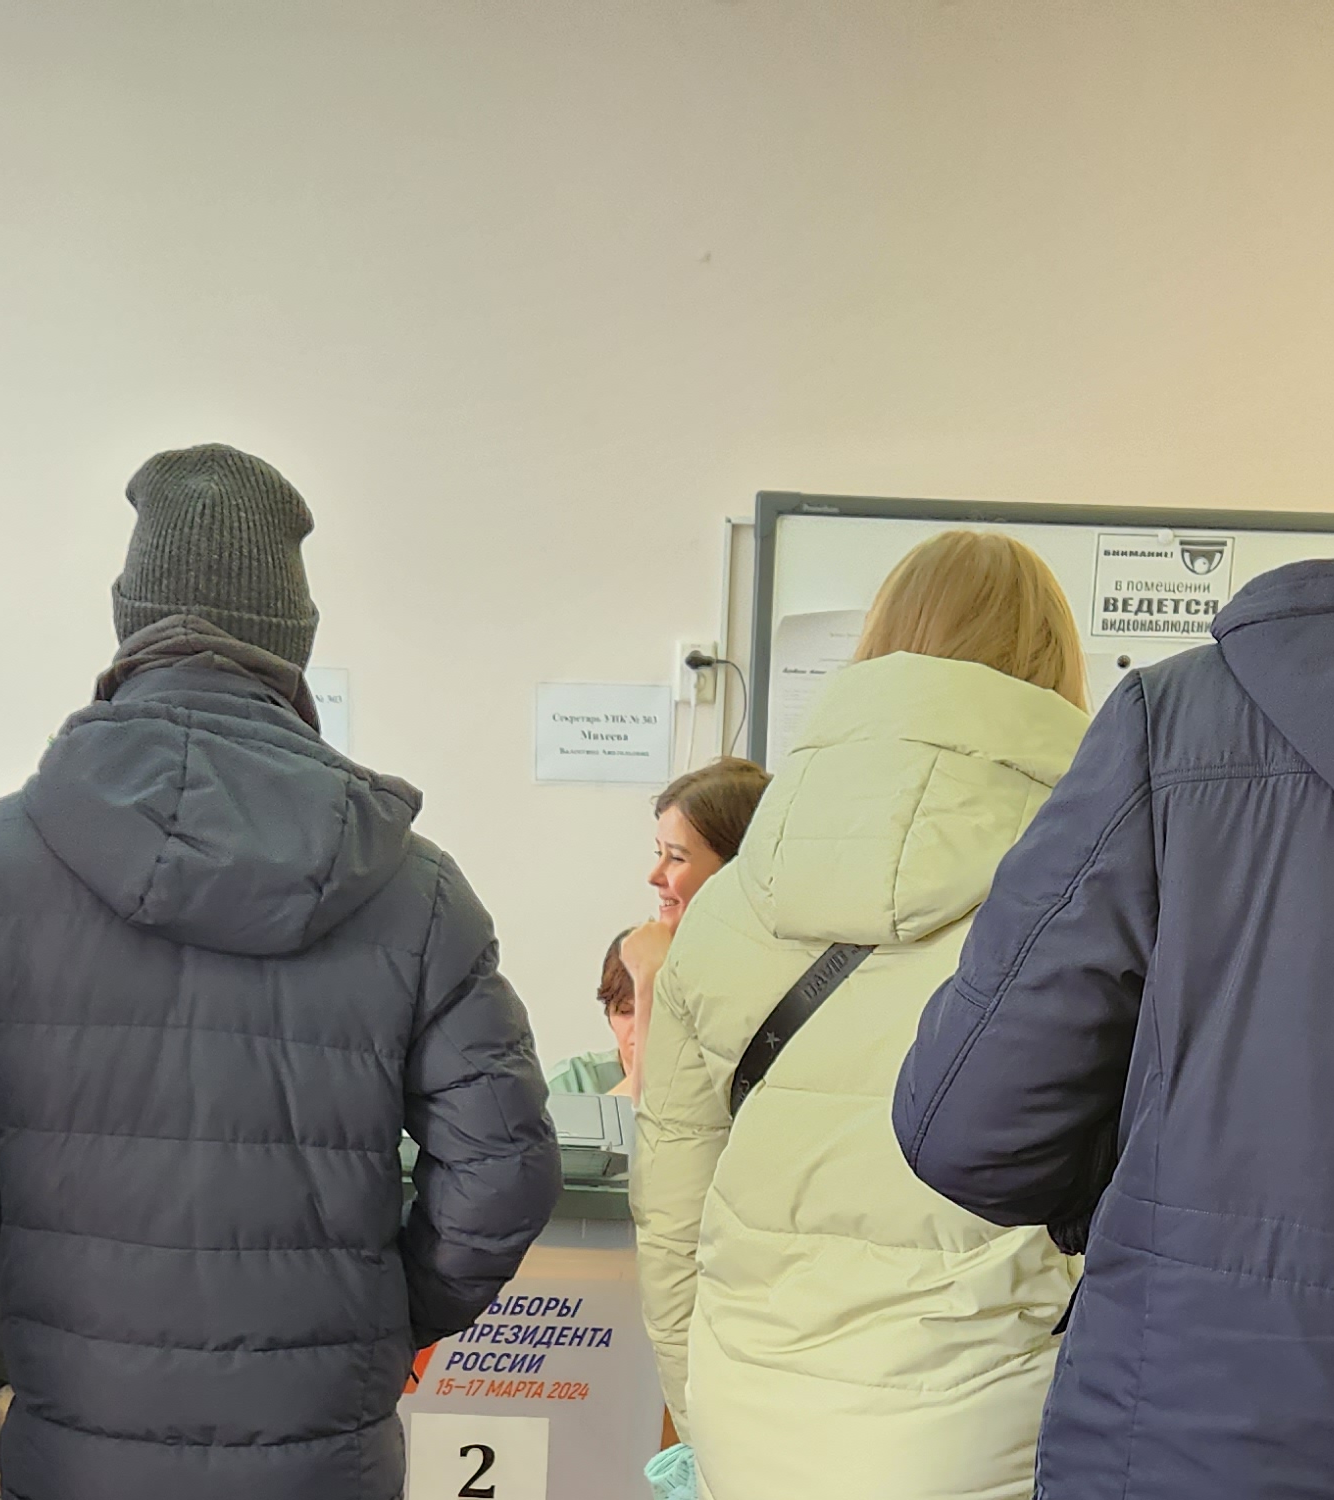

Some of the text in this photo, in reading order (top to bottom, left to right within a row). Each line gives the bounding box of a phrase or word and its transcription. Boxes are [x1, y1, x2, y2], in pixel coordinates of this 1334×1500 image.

[1126, 581, 1210, 594] помещении
[1102, 596, 1219, 616] ВЕДЕТСЯ
[1101, 618, 1211, 634] ВИДЕОНАБЛЮДЕНИ
[487, 1296, 583, 1318] ЫБОРЫ
[445, 1351, 546, 1374] РОССИИ
[485, 1380, 545, 1397] МАРТА
[546, 1382, 589, 1400] 2024
[458, 1444, 496, 1499] 2
